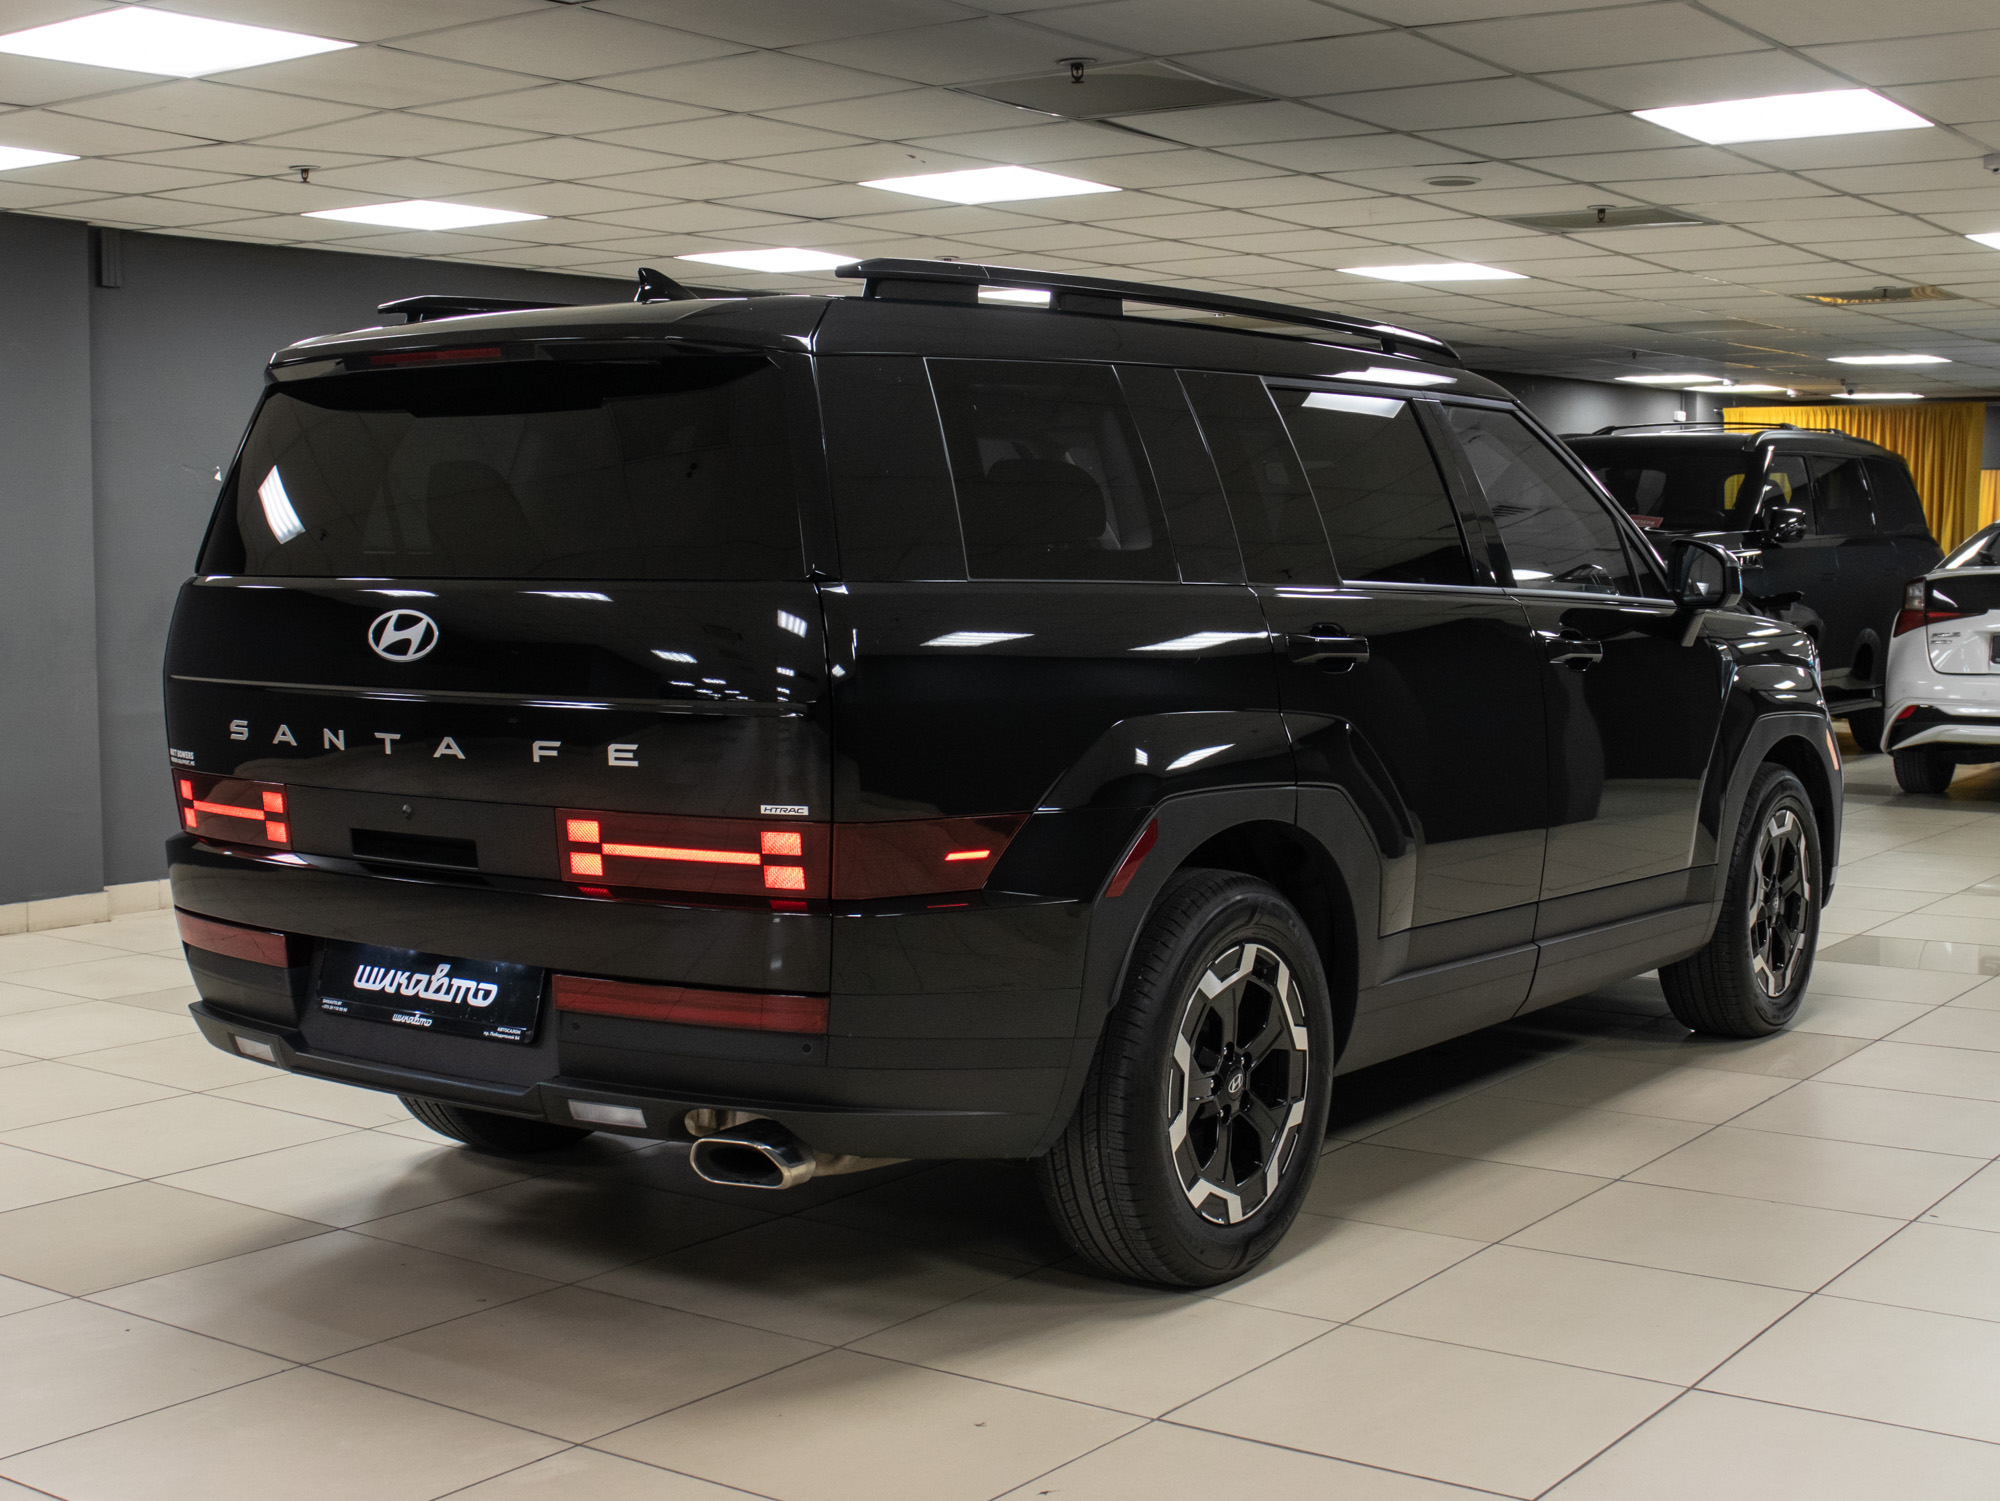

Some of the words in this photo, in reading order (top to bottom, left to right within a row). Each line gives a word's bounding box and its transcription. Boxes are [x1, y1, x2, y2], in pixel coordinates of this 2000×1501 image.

[229, 719, 466, 760] SANTA
[531, 740, 639, 767] FE
[353, 964, 498, 1007] шикавто
[392, 1014, 433, 1027] шикавто
